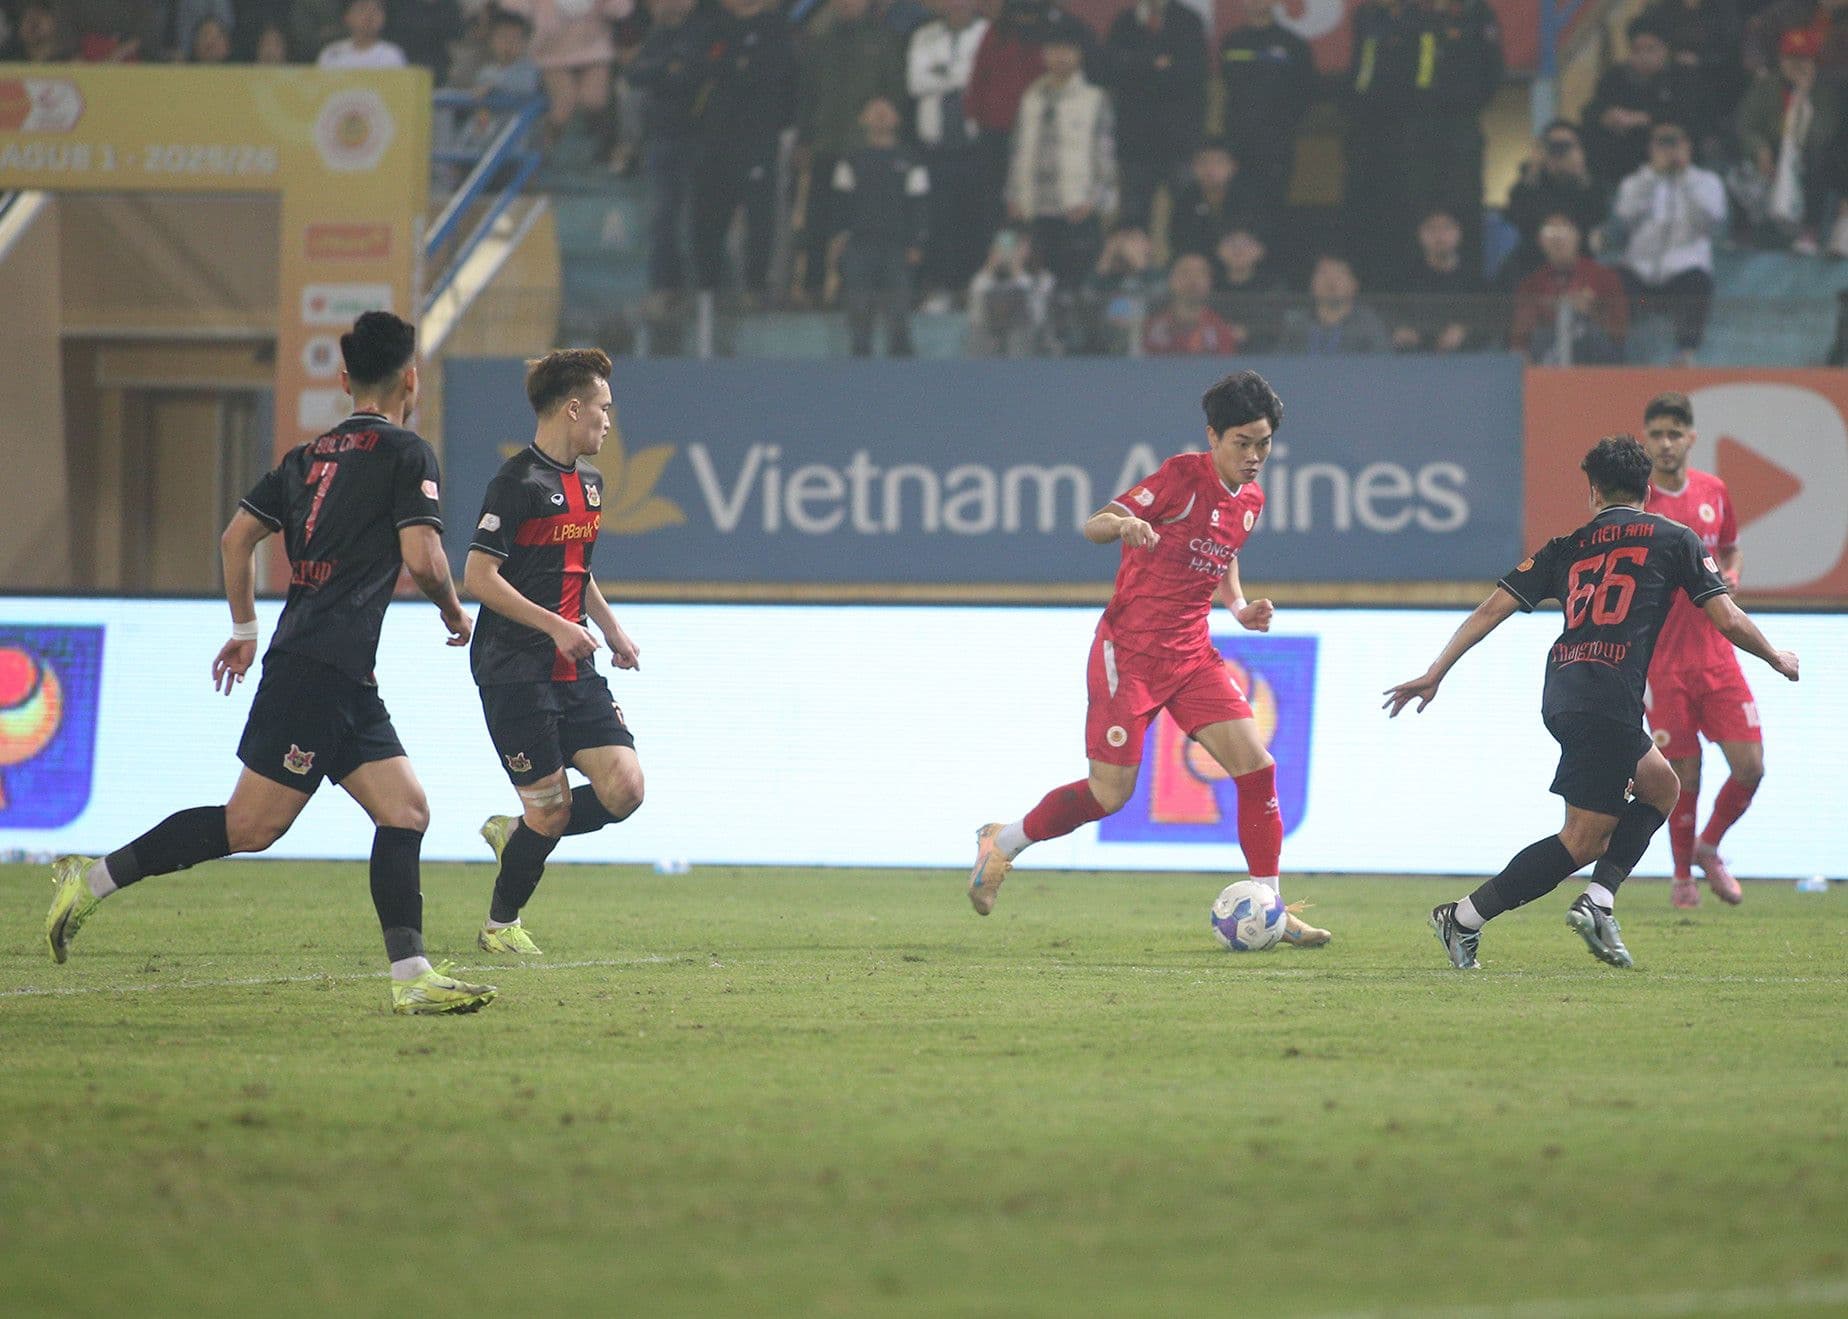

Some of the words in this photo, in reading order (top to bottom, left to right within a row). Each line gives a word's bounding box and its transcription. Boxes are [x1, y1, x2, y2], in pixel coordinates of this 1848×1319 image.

[306, 461, 337, 546] 7
[687, 442, 1092, 535] Vietnam
[1110, 443, 1468, 536] Aines
[553, 521, 593, 542] LPBank
[1189, 537, 1230, 558] CÔNG
[1566, 547, 1649, 629] 66
